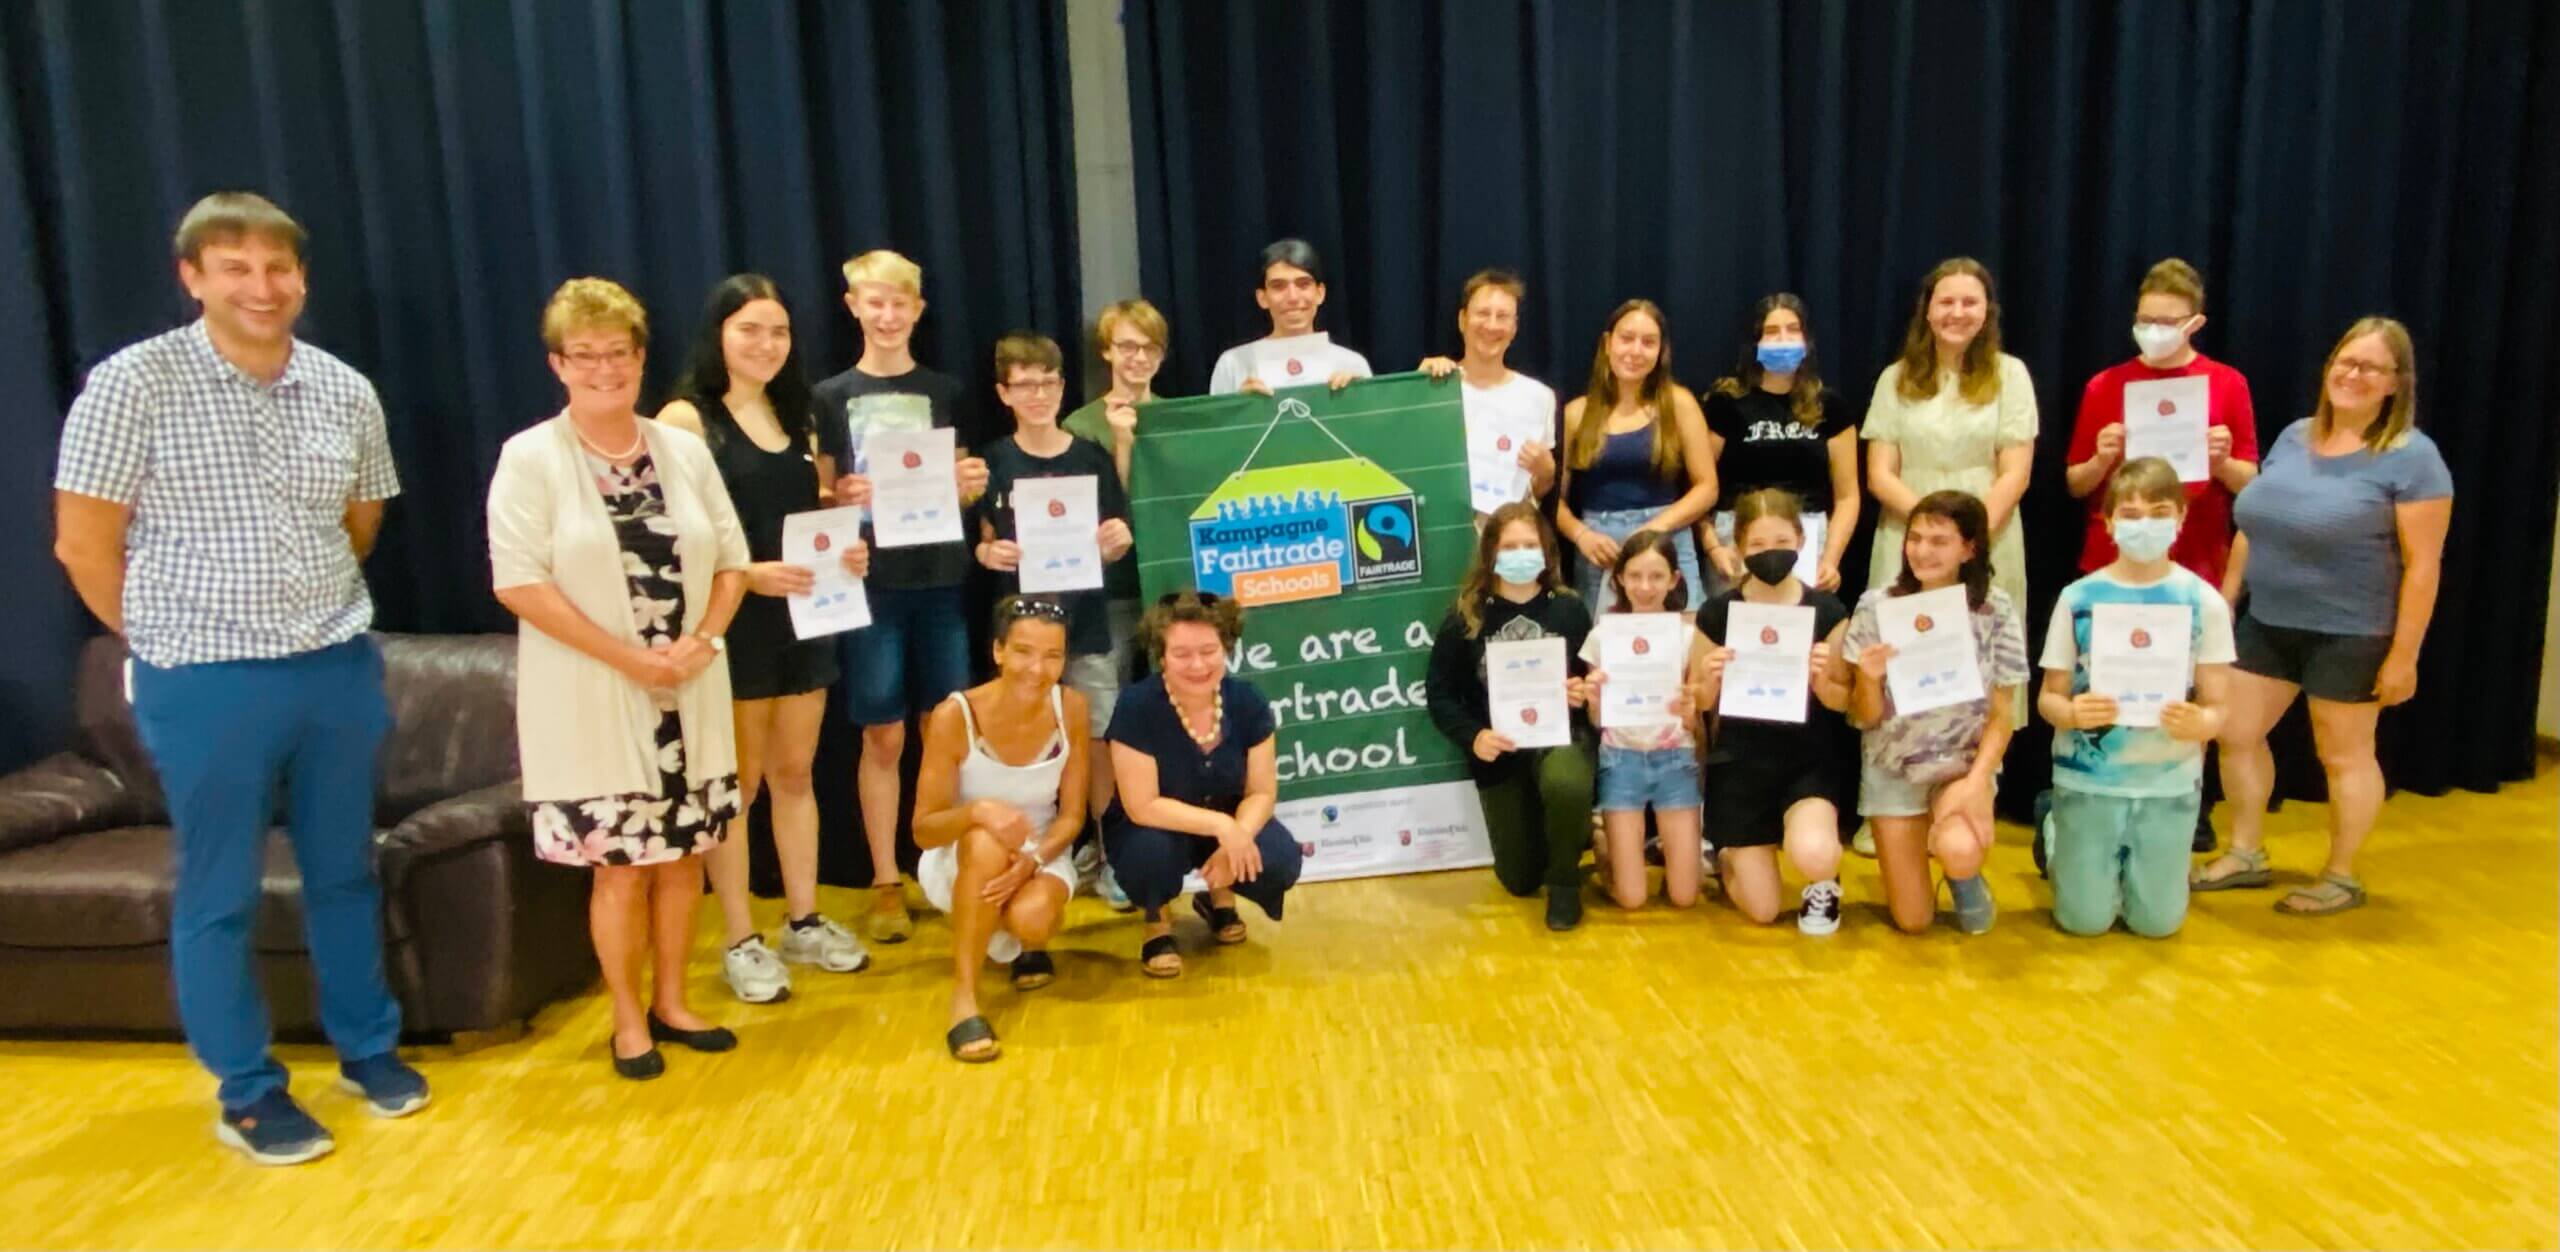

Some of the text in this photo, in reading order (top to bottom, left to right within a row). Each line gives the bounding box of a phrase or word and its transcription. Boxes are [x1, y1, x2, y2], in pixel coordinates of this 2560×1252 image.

[1199, 518, 1328, 546] Kampagne
[1200, 536, 1345, 575] Fairtrade
[1360, 560, 1416, 577] FAIRTRADE
[1242, 571, 1331, 598] Schools
[1300, 626, 1382, 662] are
[1405, 620, 1434, 647] a
[1269, 666, 1428, 729] rtrade
[1275, 727, 1417, 781] chool
